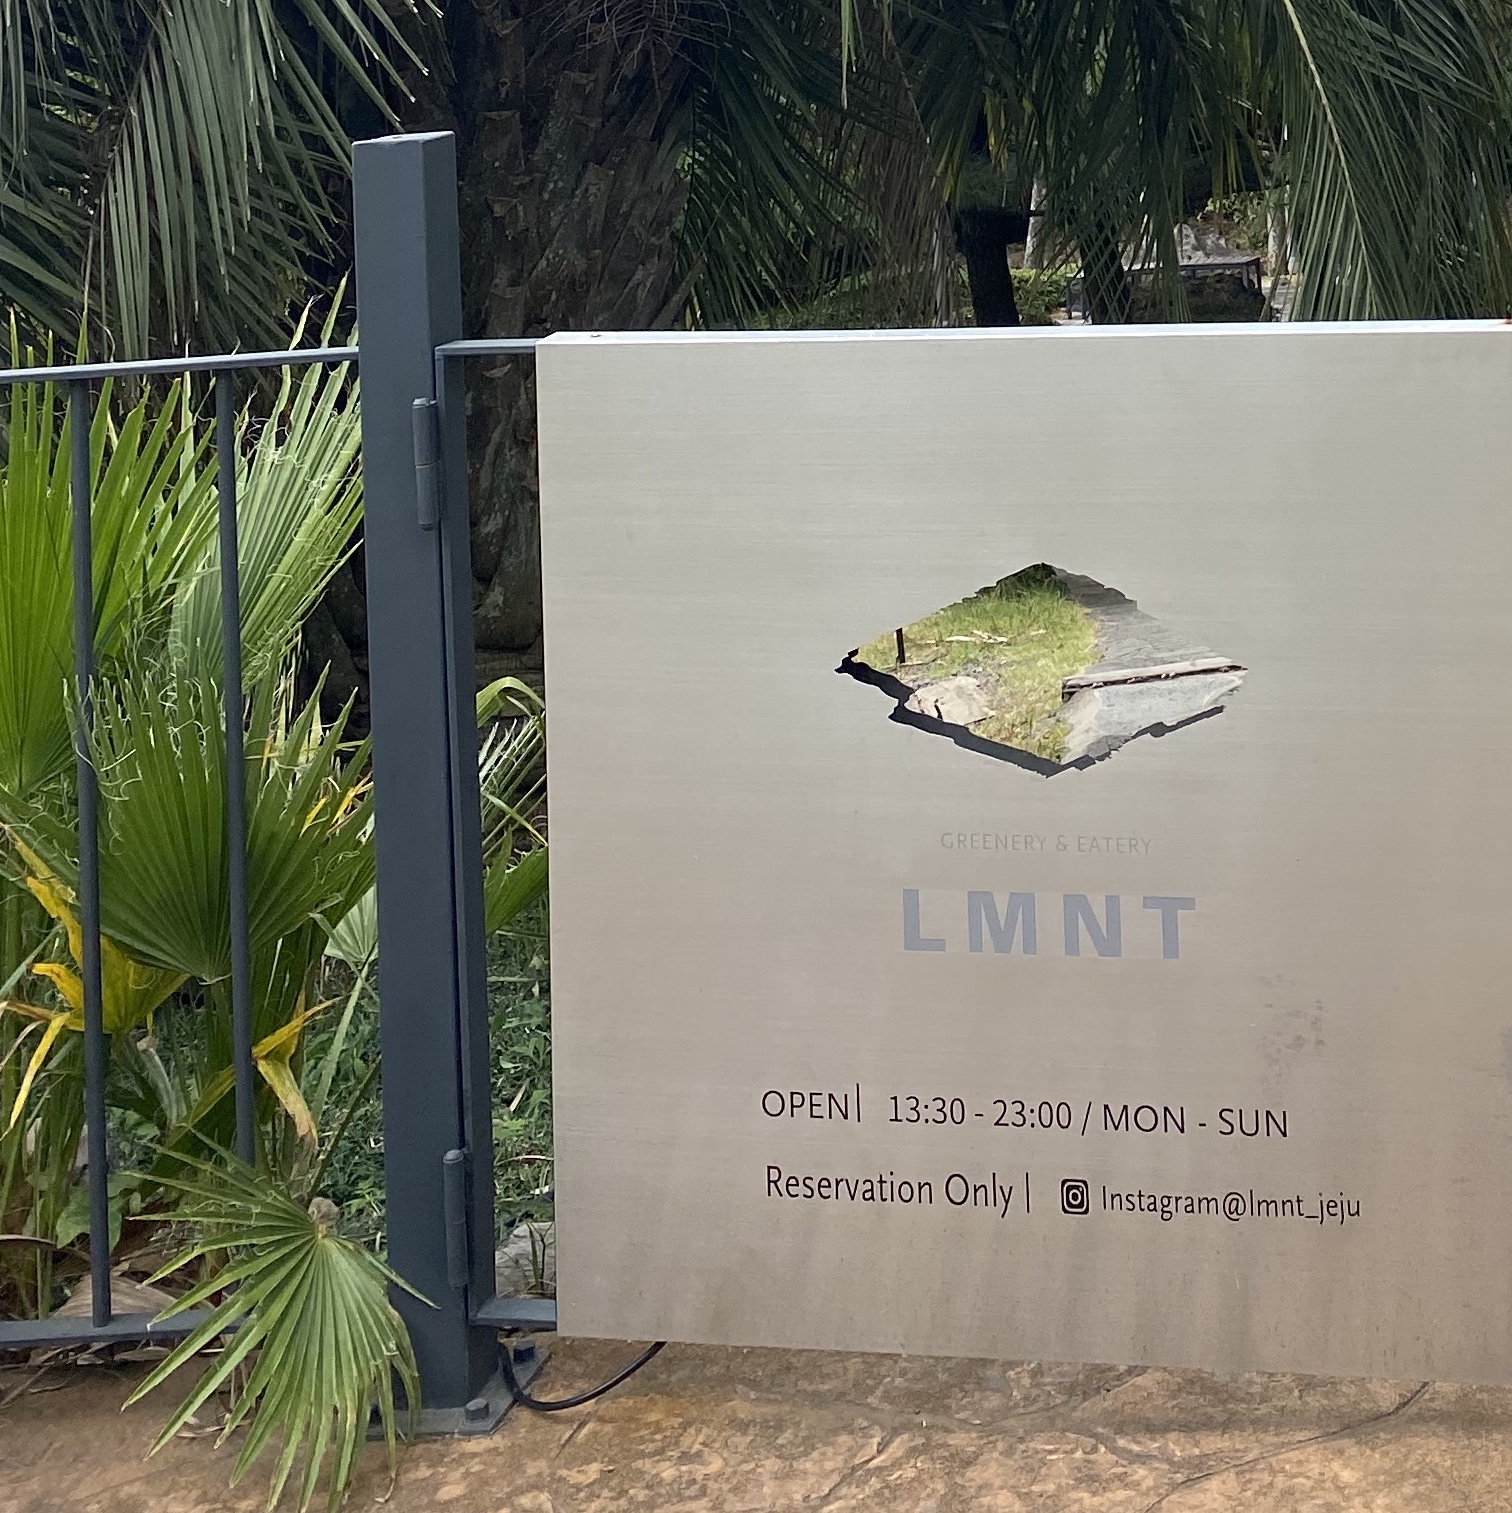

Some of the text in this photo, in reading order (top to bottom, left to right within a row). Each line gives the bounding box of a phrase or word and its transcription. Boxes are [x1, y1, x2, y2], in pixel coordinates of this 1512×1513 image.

[940, 832, 1152, 855] GREENERY & EATERY
[902, 888, 1196, 959] LMNT
[888, 1095, 966, 1125] 13:30
[992, 1099, 1072, 1128] 23:00
[1103, 1104, 1186, 1134] MON
[1218, 1108, 1288, 1137] SUN
[766, 1165, 934, 1205] Reservation
[944, 1171, 1013, 1219] Only
[1101, 1185, 1361, 1226] Instagram@lmnt_jeju
